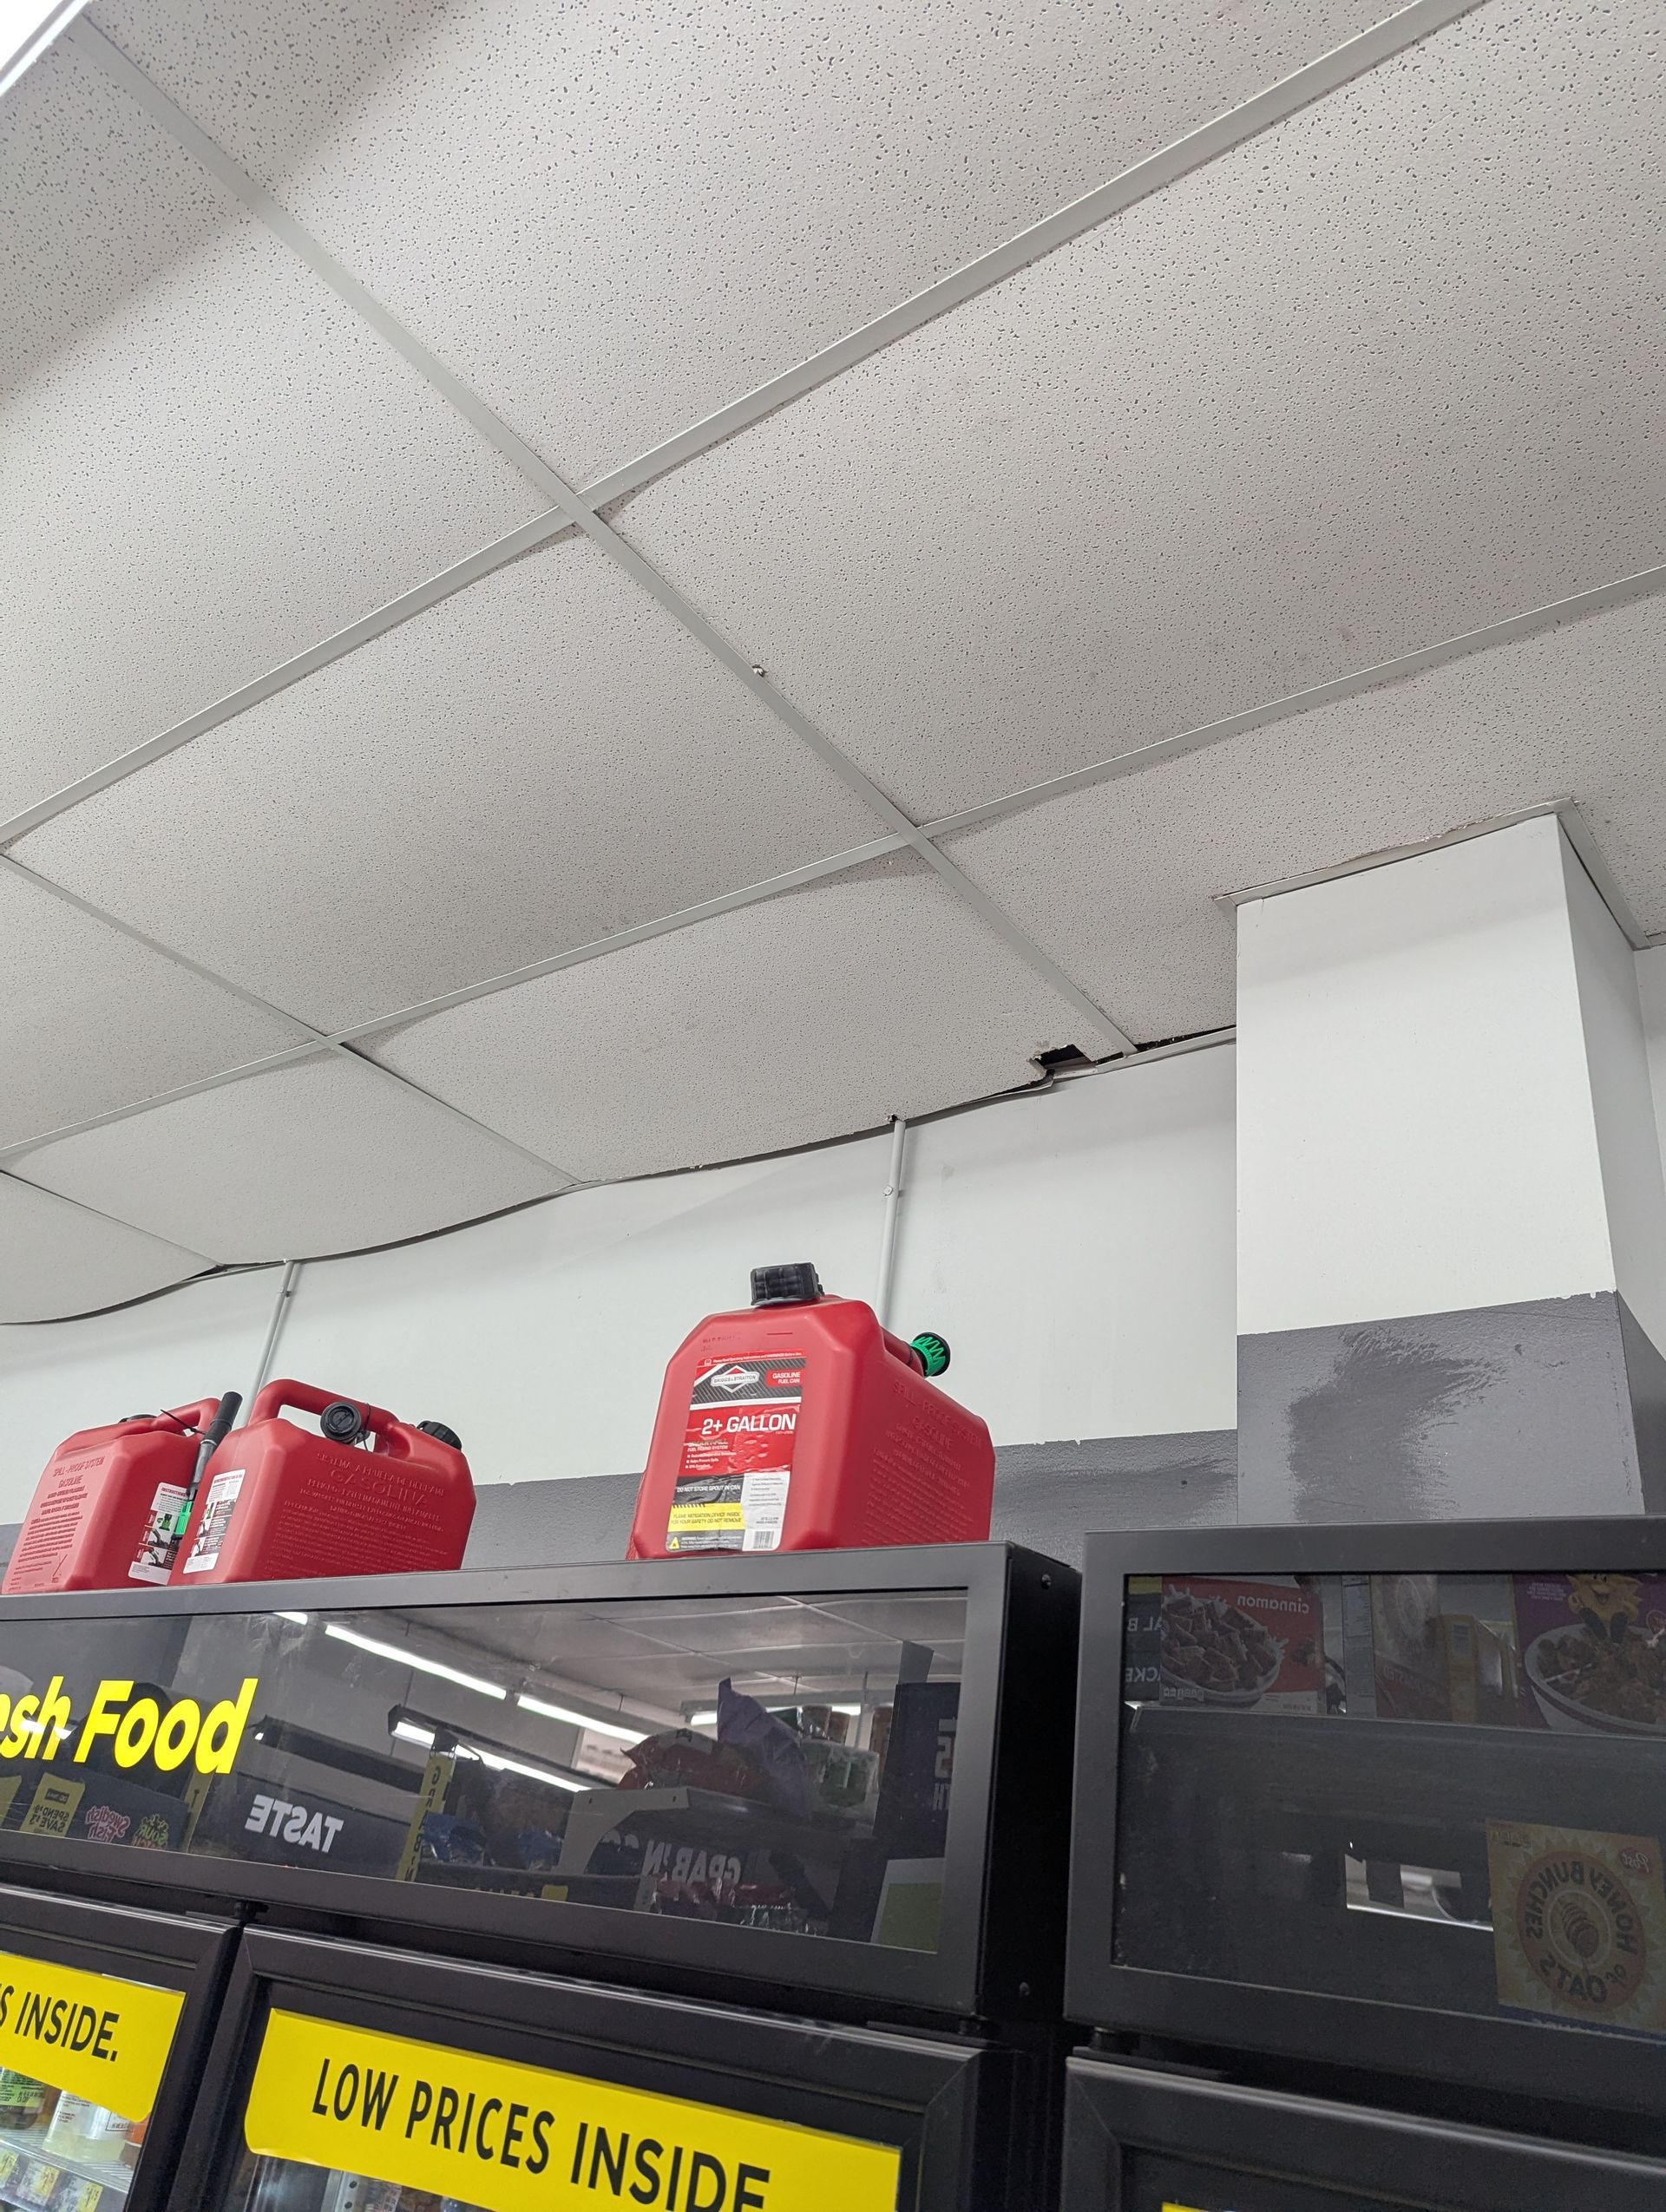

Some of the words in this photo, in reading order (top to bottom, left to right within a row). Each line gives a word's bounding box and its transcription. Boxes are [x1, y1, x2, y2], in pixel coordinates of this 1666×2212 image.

[701, 1418, 723, 1435] 2+
[727, 1414, 797, 1432] GALLON
[330, 1469, 427, 1508] GASOLINA
[74, 1678, 259, 1775] Food
[15, 1992, 120, 2062] INSIDE.
[312, 2058, 399, 2132] LOW
[405, 2080, 554, 2175] PRICES
[570, 2122, 771, 2212] INSIDE
